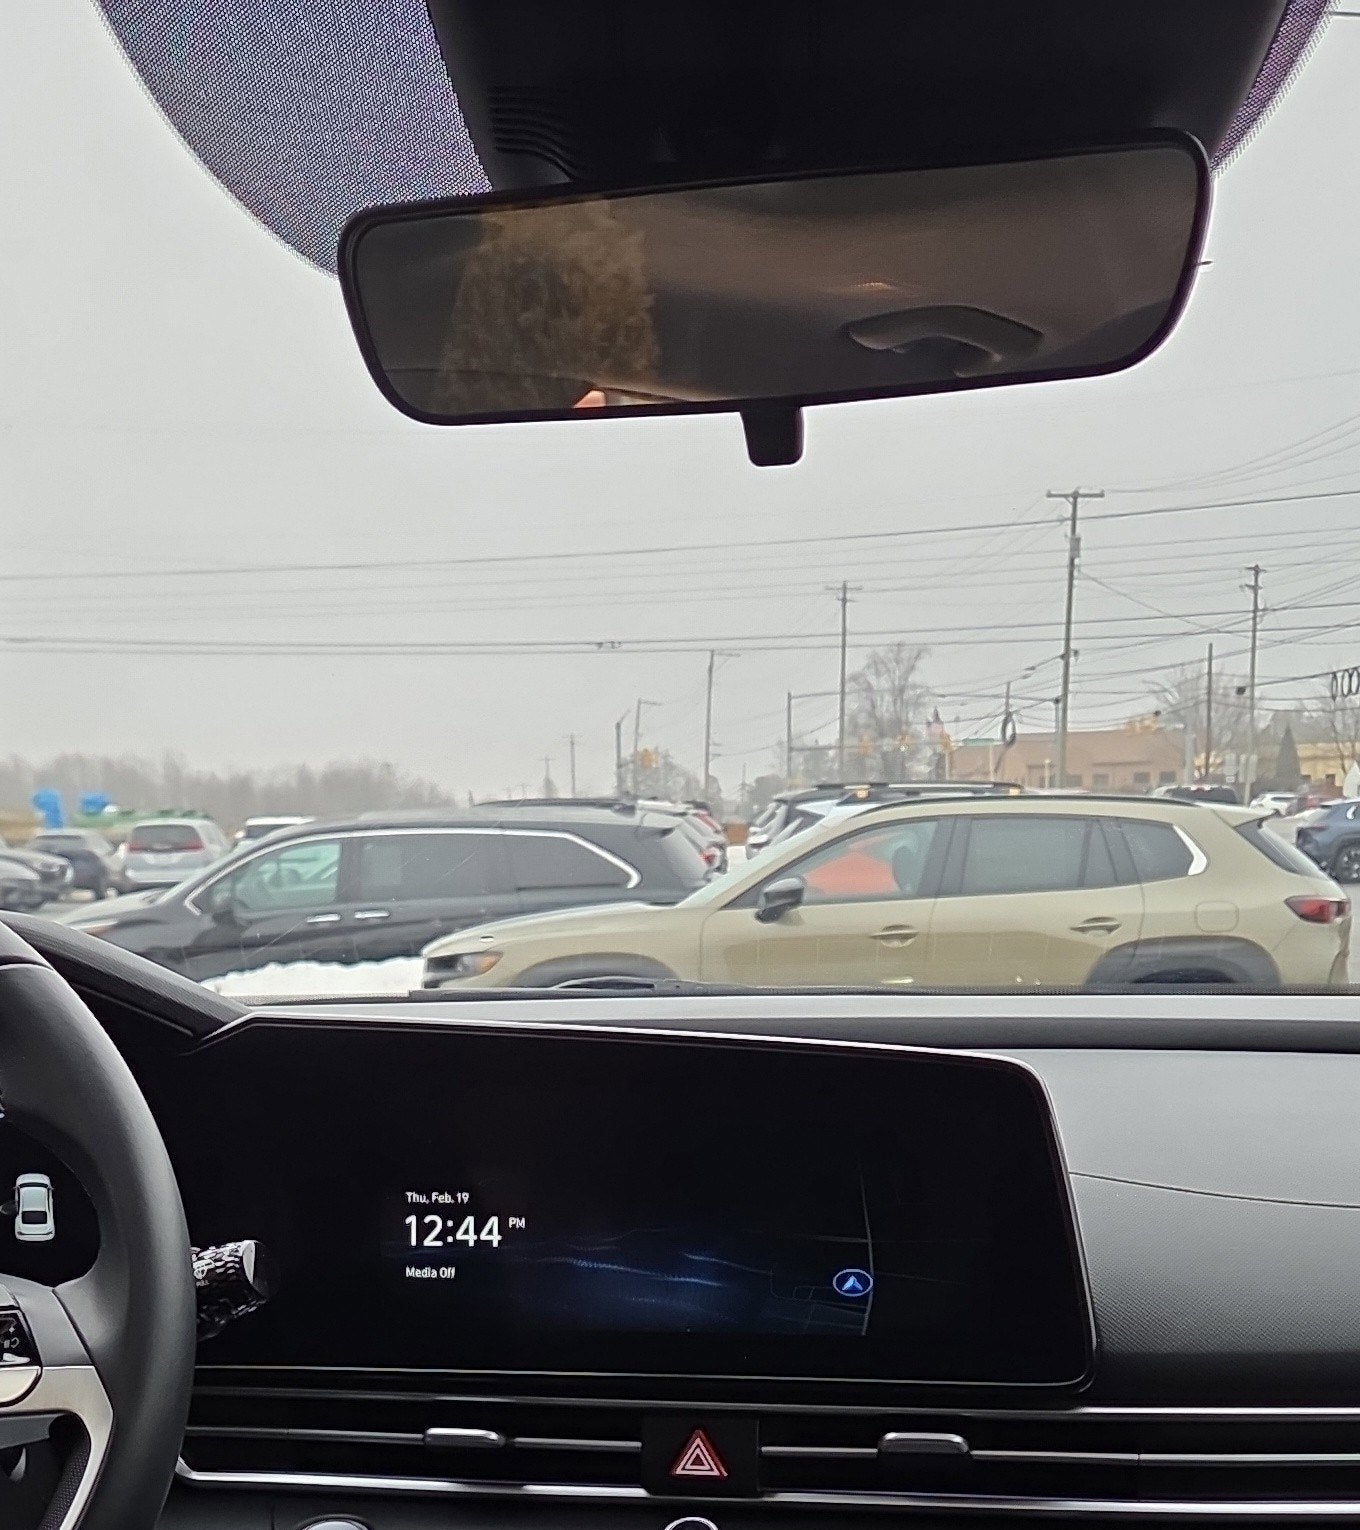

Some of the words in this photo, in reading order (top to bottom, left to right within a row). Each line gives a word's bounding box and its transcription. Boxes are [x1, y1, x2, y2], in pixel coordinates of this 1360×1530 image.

[405, 1191, 430, 1205] Thu,
[431, 1191, 455, 1204] Feb.
[456, 1191, 470, 1204] 19
[404, 1214, 503, 1248] 12:44
[508, 1216, 526, 1229] PM
[405, 1265, 438, 1279] Media
[439, 1266, 456, 1279] Off
